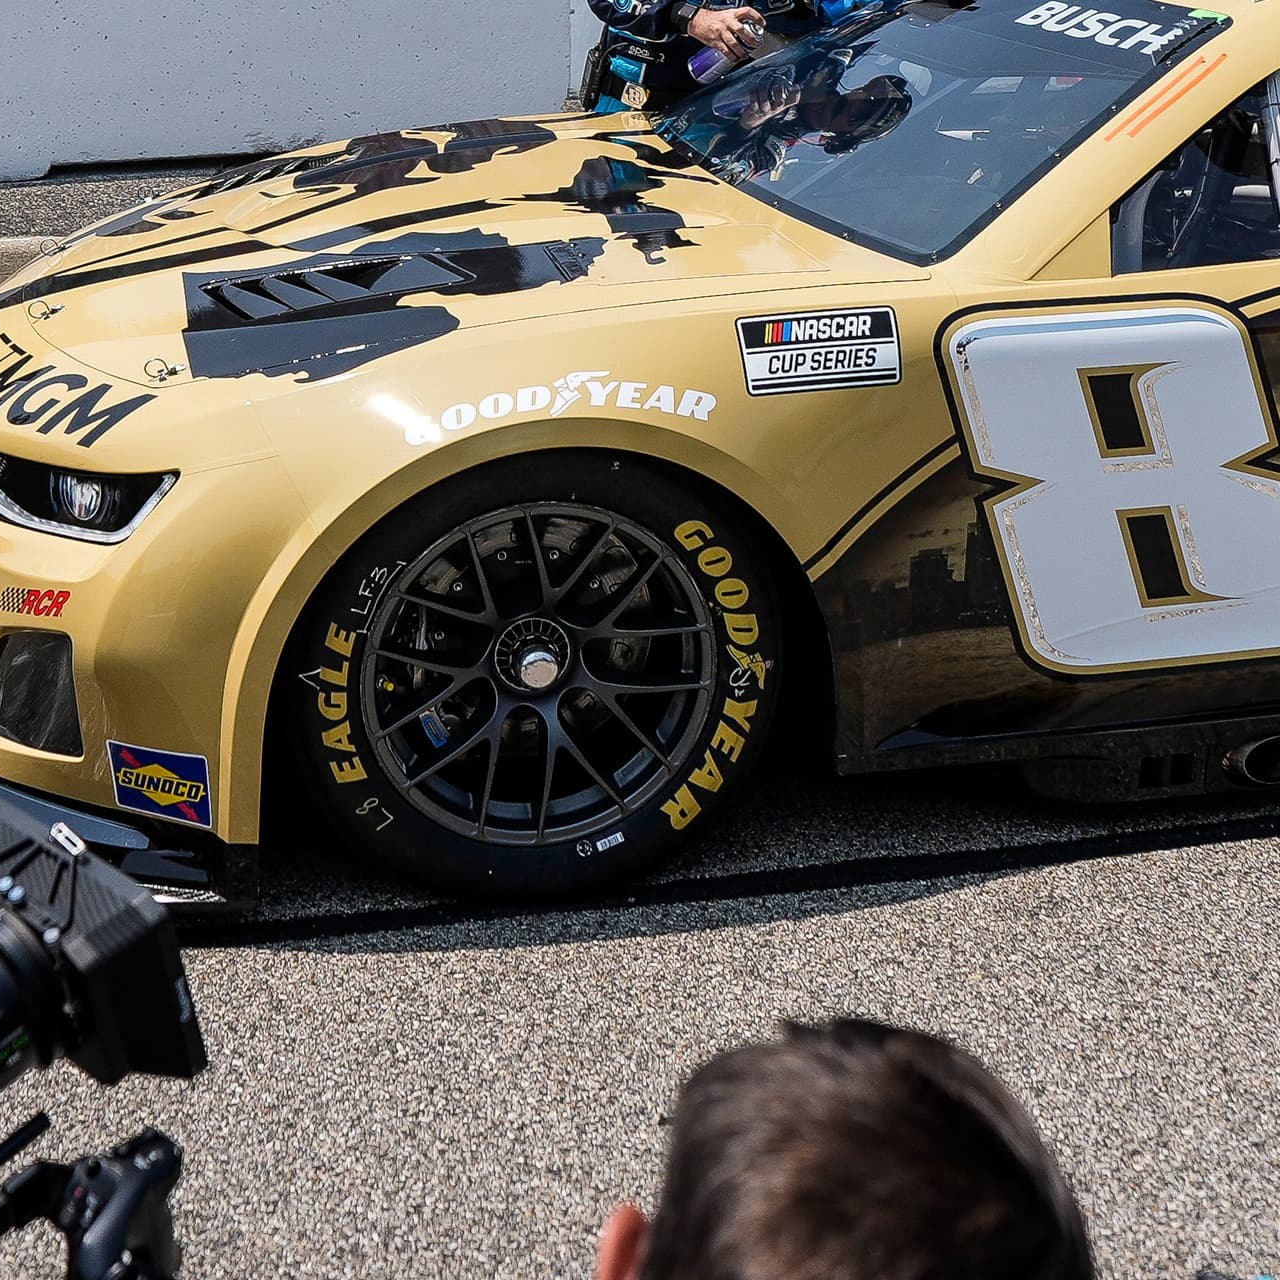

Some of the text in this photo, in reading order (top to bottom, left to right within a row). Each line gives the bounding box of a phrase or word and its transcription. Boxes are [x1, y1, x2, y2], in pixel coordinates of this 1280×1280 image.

[1015, 0, 1178, 55] BUSCH
[791, 315, 872, 342] NASCAR
[768, 347, 878, 375] CUP SERIES
[20, 588, 71, 618] RCR
[660, 520, 759, 830] GOODYEAR
[317, 622, 369, 784] EAGLE
[121, 767, 203, 802] SUNOCO
